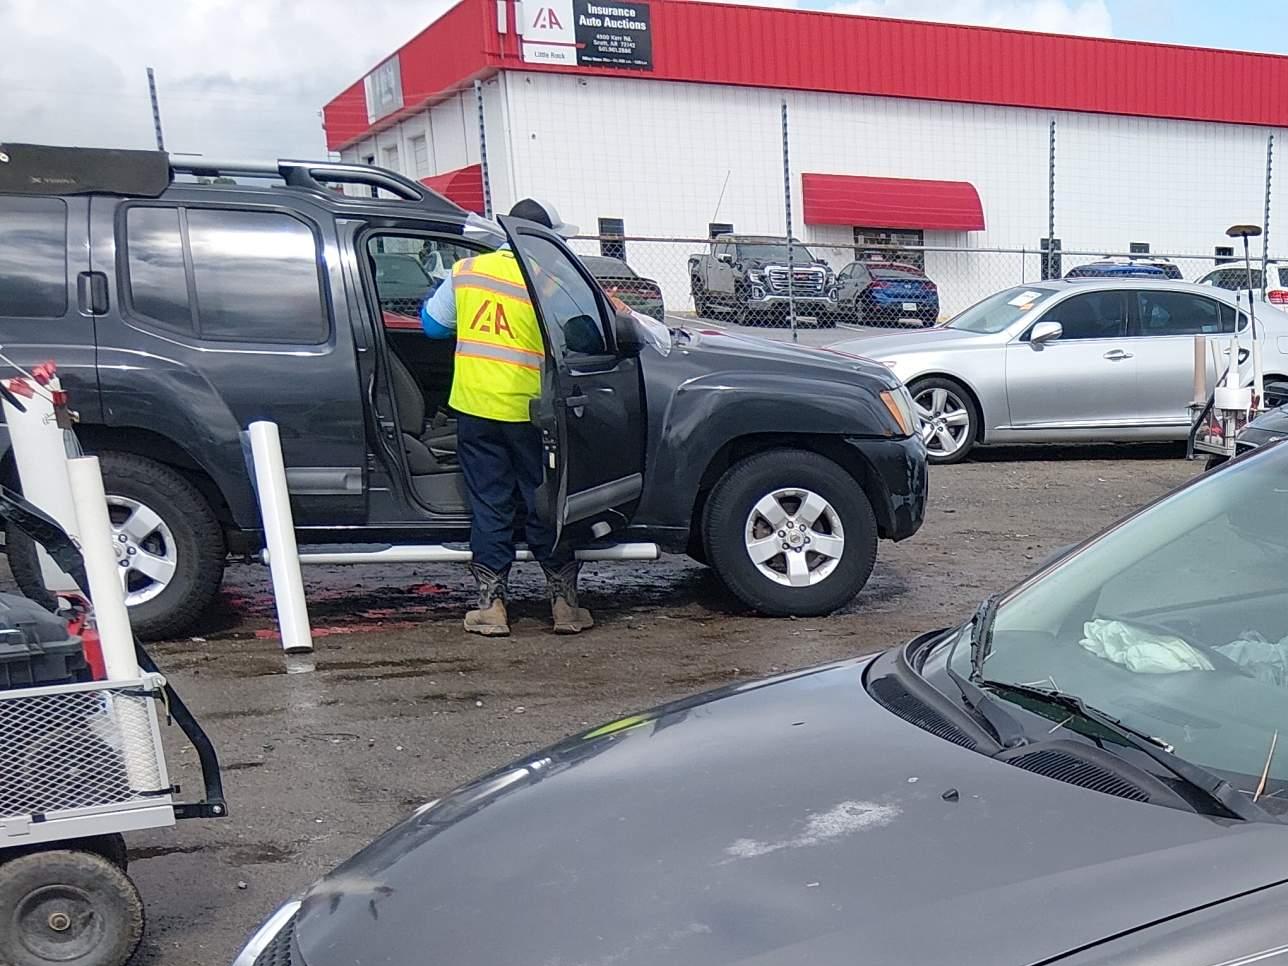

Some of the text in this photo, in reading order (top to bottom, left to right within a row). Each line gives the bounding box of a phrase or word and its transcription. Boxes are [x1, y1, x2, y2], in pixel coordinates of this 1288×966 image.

[587, 3, 636, 17] Insurance
[579, 15, 647, 30] Auto Auctions
